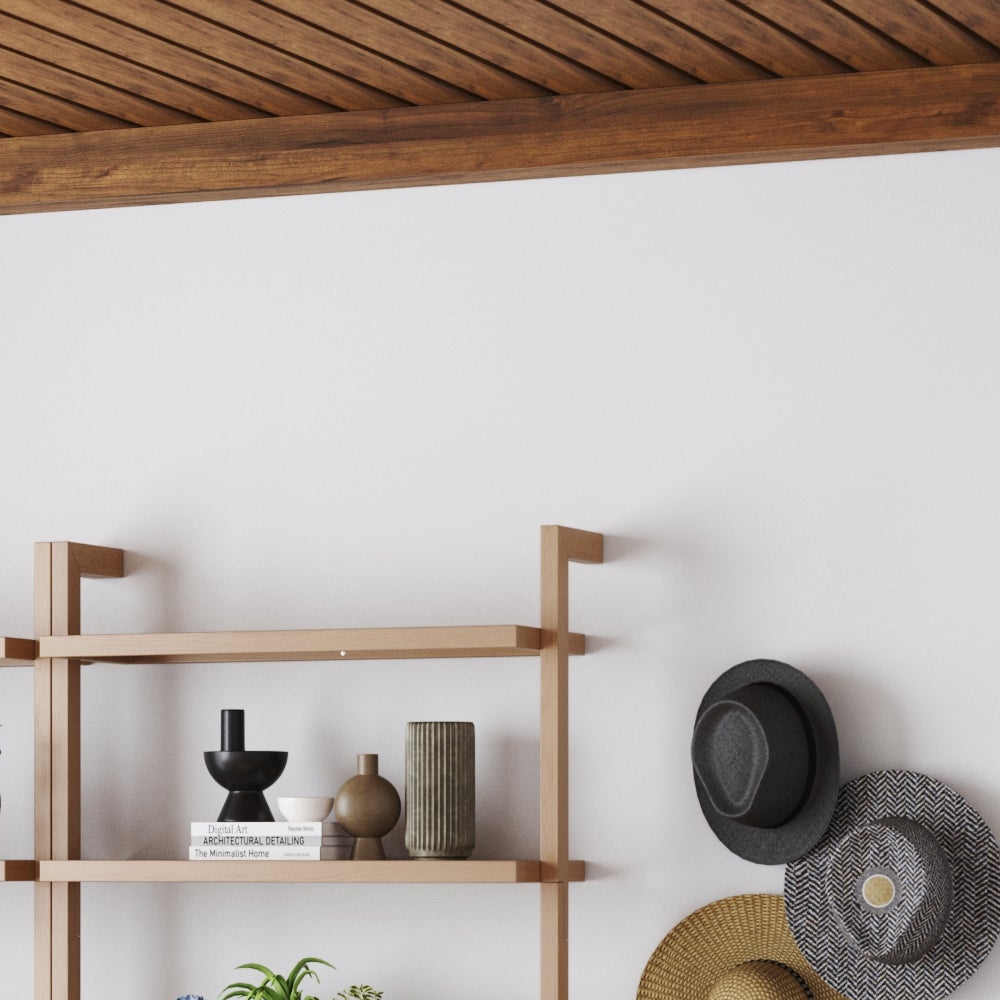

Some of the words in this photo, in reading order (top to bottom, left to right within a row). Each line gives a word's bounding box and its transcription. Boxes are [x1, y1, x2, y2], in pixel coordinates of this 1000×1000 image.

[208, 825, 234, 836] Digital
[235, 825, 248, 834] Art
[203, 836, 263, 846] ARCHITECTURAL
[265, 836, 305, 846] DETAILING
[195, 849, 208, 858] The
[209, 849, 247, 858] Minimalist
[248, 849, 270, 858] Home
